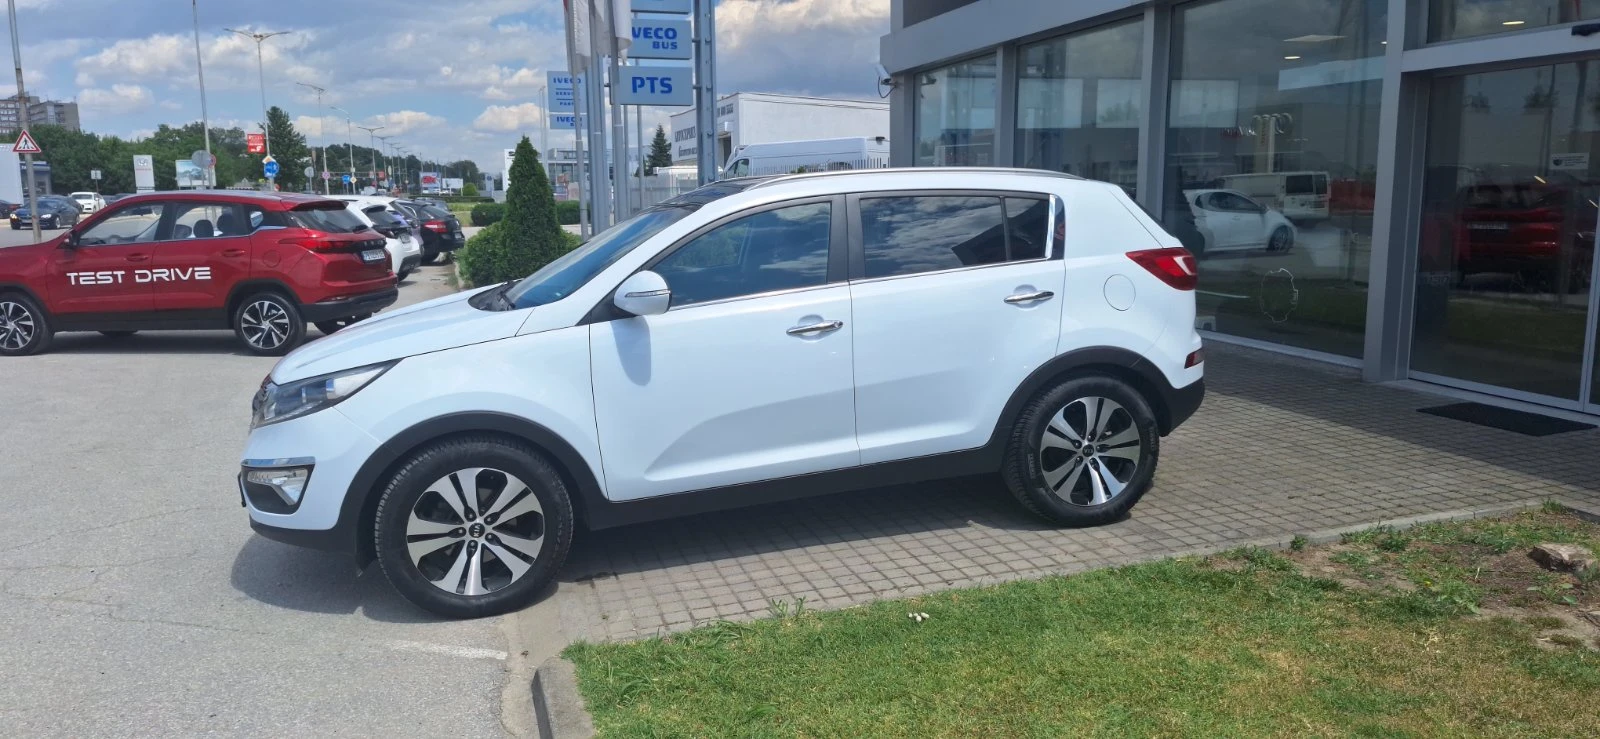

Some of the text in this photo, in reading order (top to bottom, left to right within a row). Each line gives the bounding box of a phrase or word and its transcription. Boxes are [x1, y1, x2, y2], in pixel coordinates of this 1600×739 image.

[631, 27, 677, 40] VECO
[652, 41, 678, 50] BUS
[631, 76, 673, 94] PTS
[66, 266, 211, 286] TEST DRIVE
